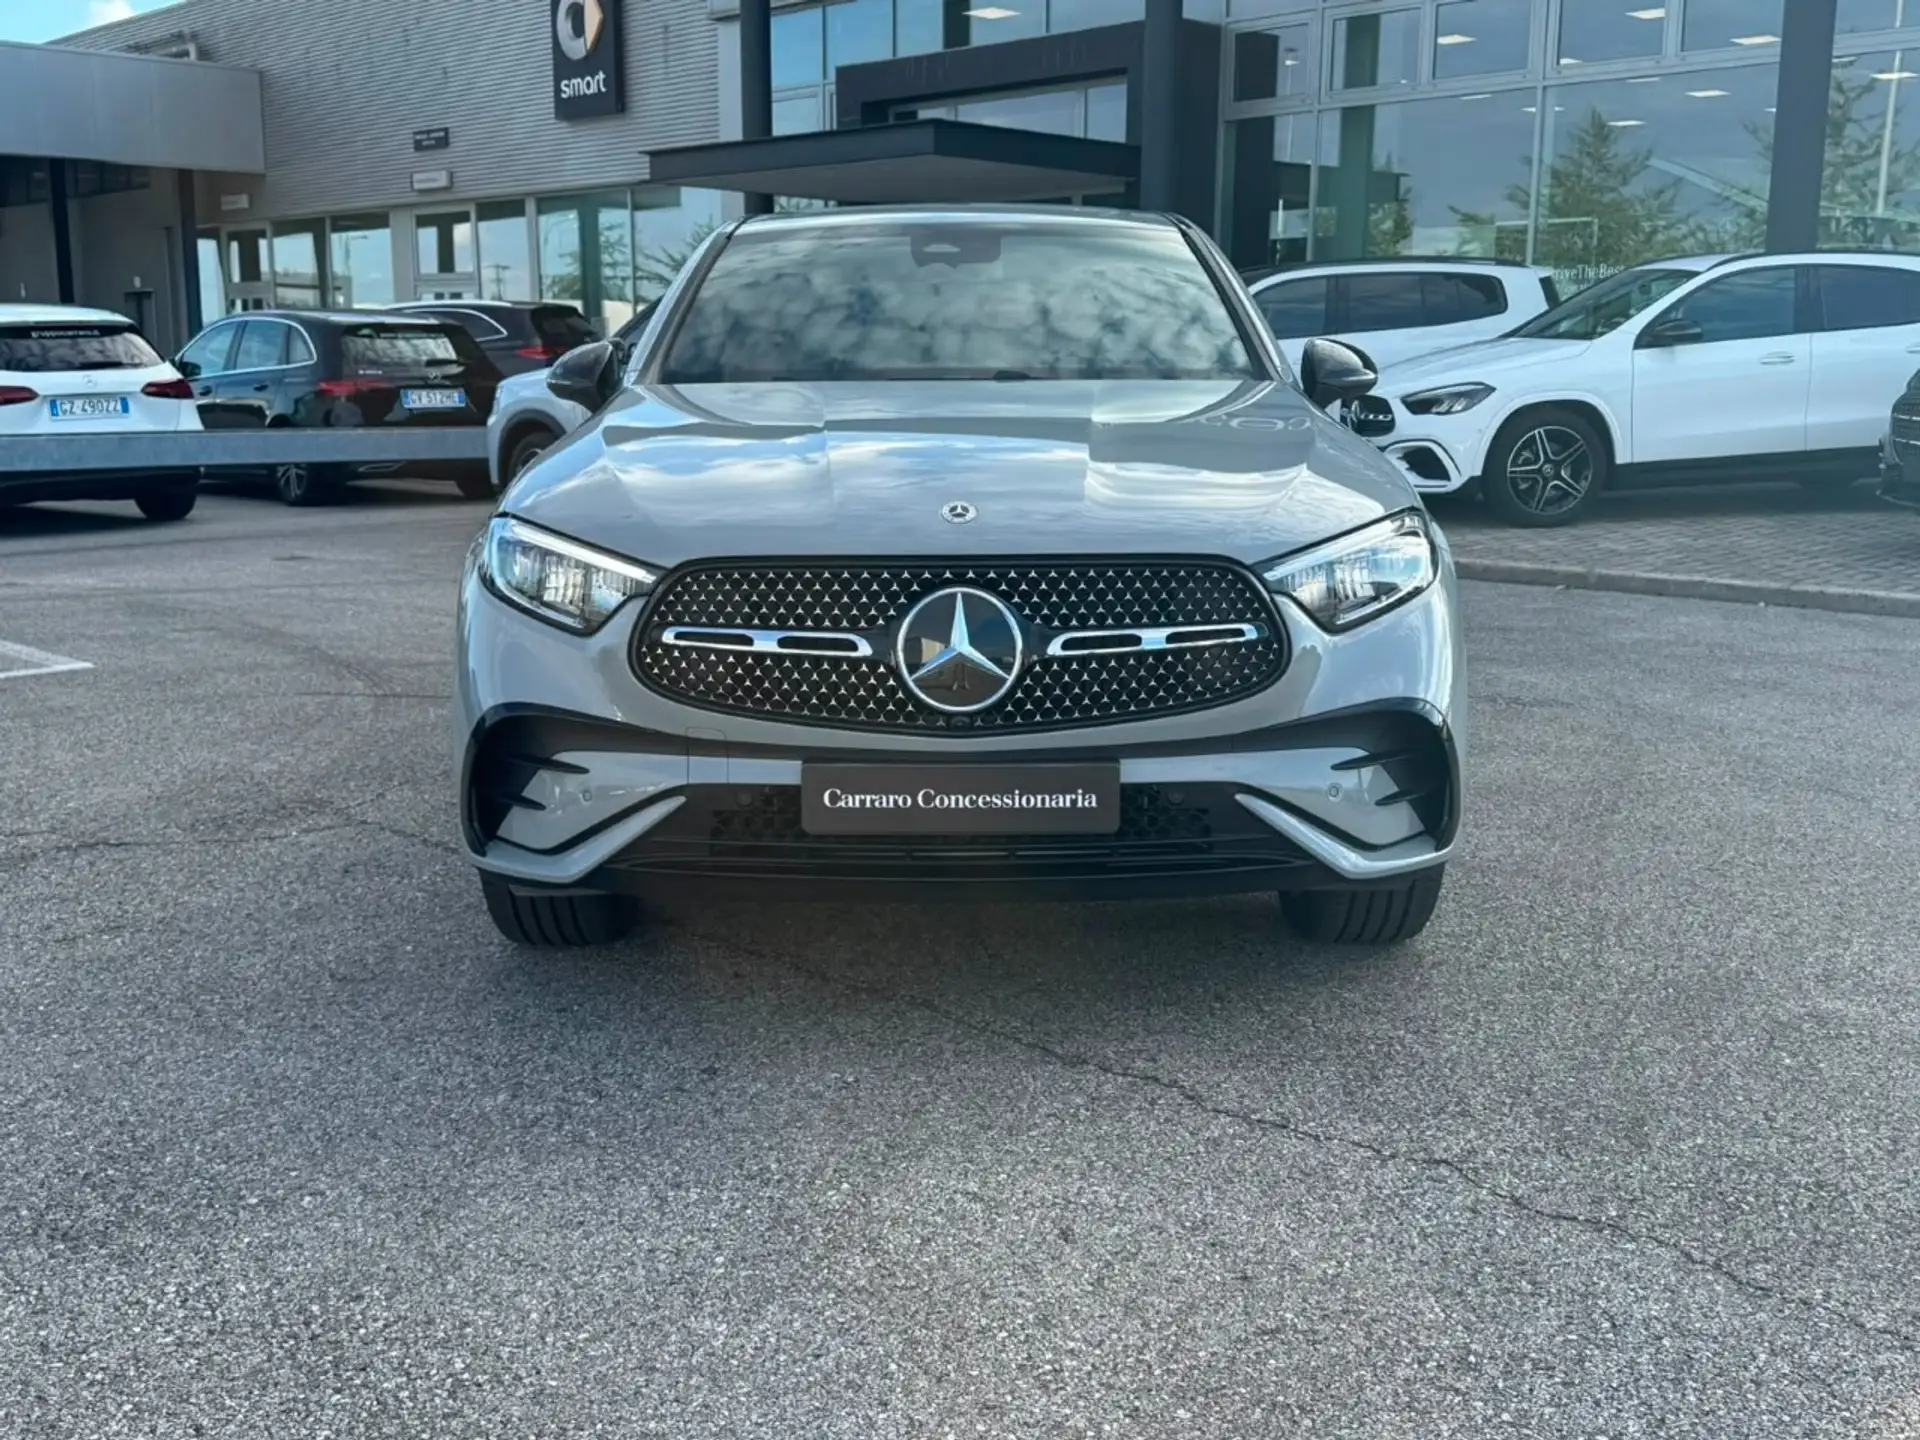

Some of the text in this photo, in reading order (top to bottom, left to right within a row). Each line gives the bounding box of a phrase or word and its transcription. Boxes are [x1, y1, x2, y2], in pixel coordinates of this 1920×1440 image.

[560, 70, 607, 99] smart
[823, 788, 1098, 809] Carraro Concessionaria
